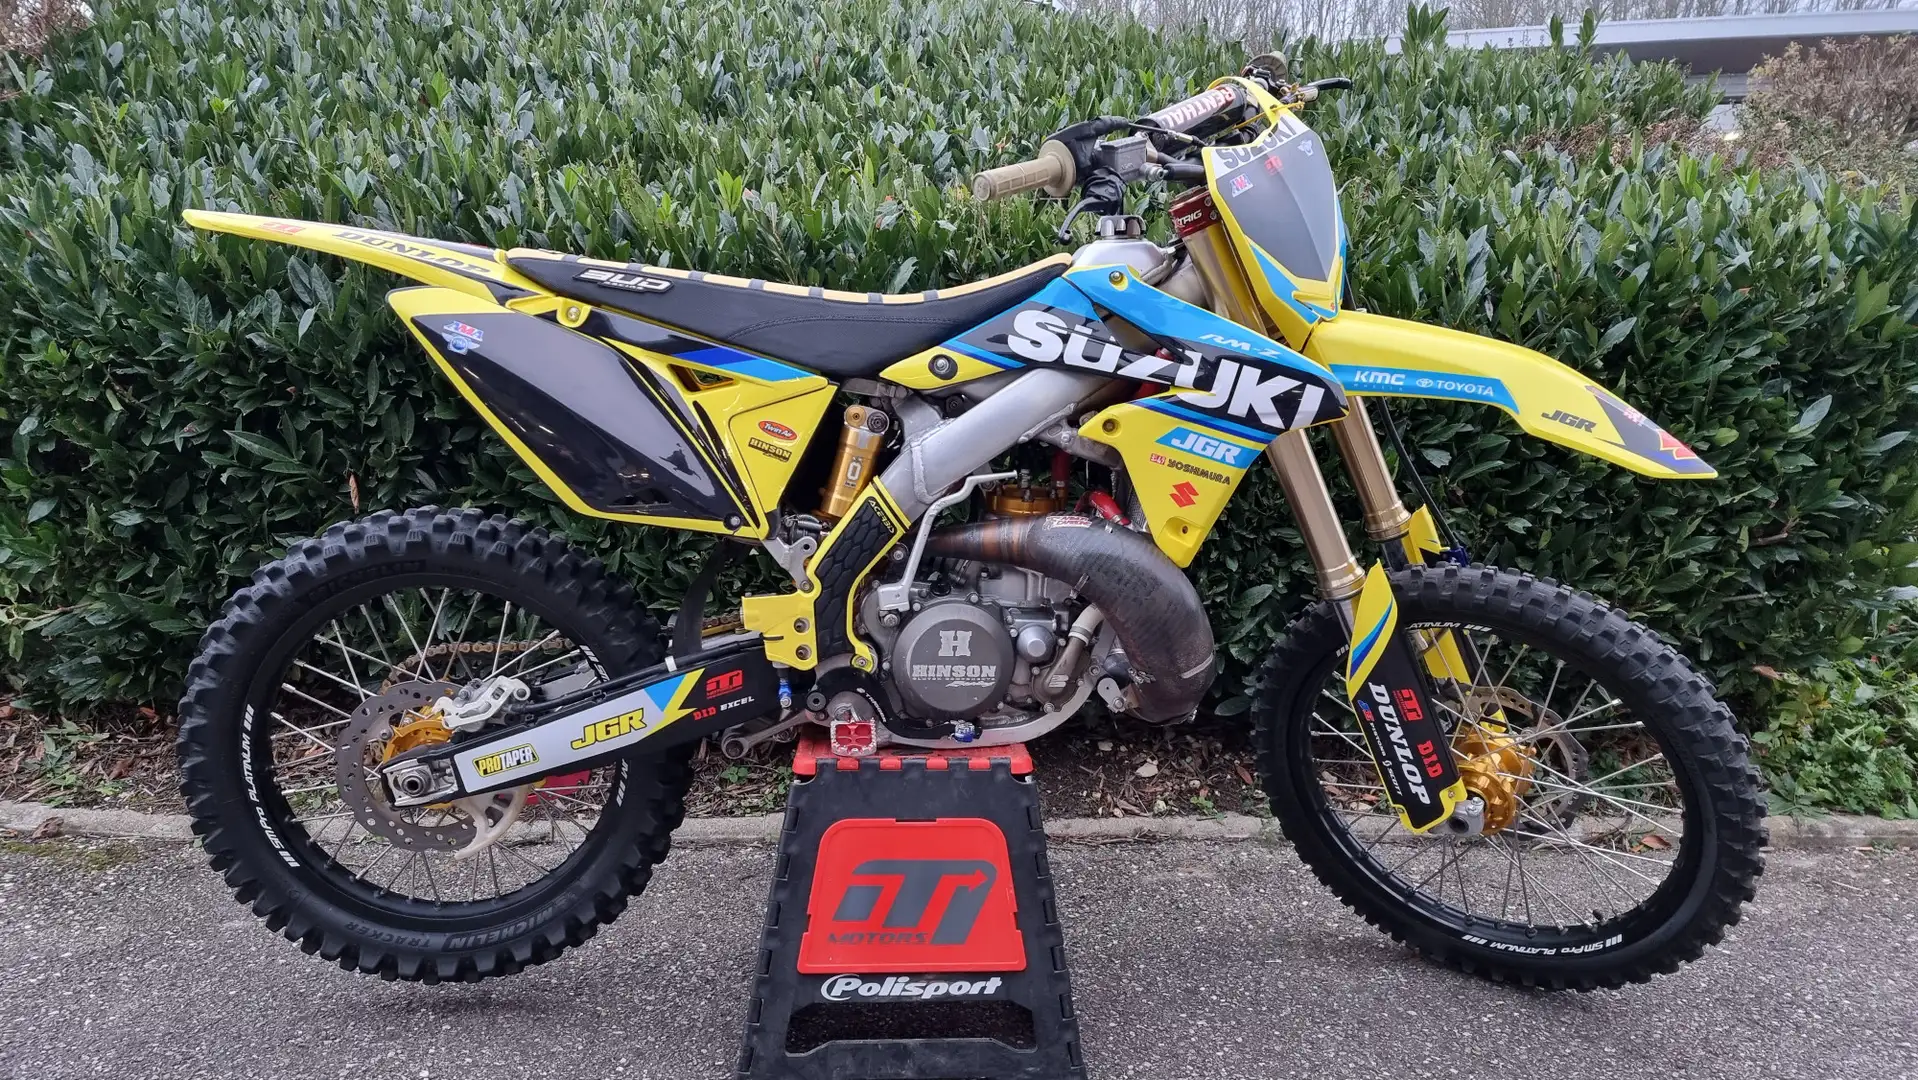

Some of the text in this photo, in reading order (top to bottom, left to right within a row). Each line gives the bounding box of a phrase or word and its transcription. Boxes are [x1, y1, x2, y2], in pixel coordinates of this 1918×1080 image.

[1160, 86, 1236, 129] RENTHAL
[332, 231, 491, 273] DUNLOP
[580, 269, 671, 290] BUD
[1199, 333, 1281, 359] RM-Z
[1354, 370, 1406, 386] KMC
[1437, 380, 1495, 397] TOYOTA
[1541, 409, 1597, 433] JGR
[750, 438, 791, 458] HINSON
[1171, 433, 1241, 464] JGR
[1167, 459, 1231, 485] YOSHIMURA
[869, 500, 895, 533] ACERBIS
[1405, 621, 1461, 629] ATINUM
[938, 630, 973, 657] H
[912, 665, 997, 678] HINSON
[720, 696, 755, 711] EXCEL
[571, 708, 647, 749] JGR
[1368, 682, 1431, 805] DUNLOP
[242, 733, 260, 802] PLATINUM
[478, 746, 534, 776] PROTAPER
[1369, 722, 1403, 797] PISTONS SCOTT
[345, 921, 431, 949] TRACKER
[448, 906, 553, 949] MICHELIN
[826, 931, 928, 946] MOTORS
[1489, 941, 1557, 955] PLATINUM
[821, 974, 1002, 1001] Polisport
